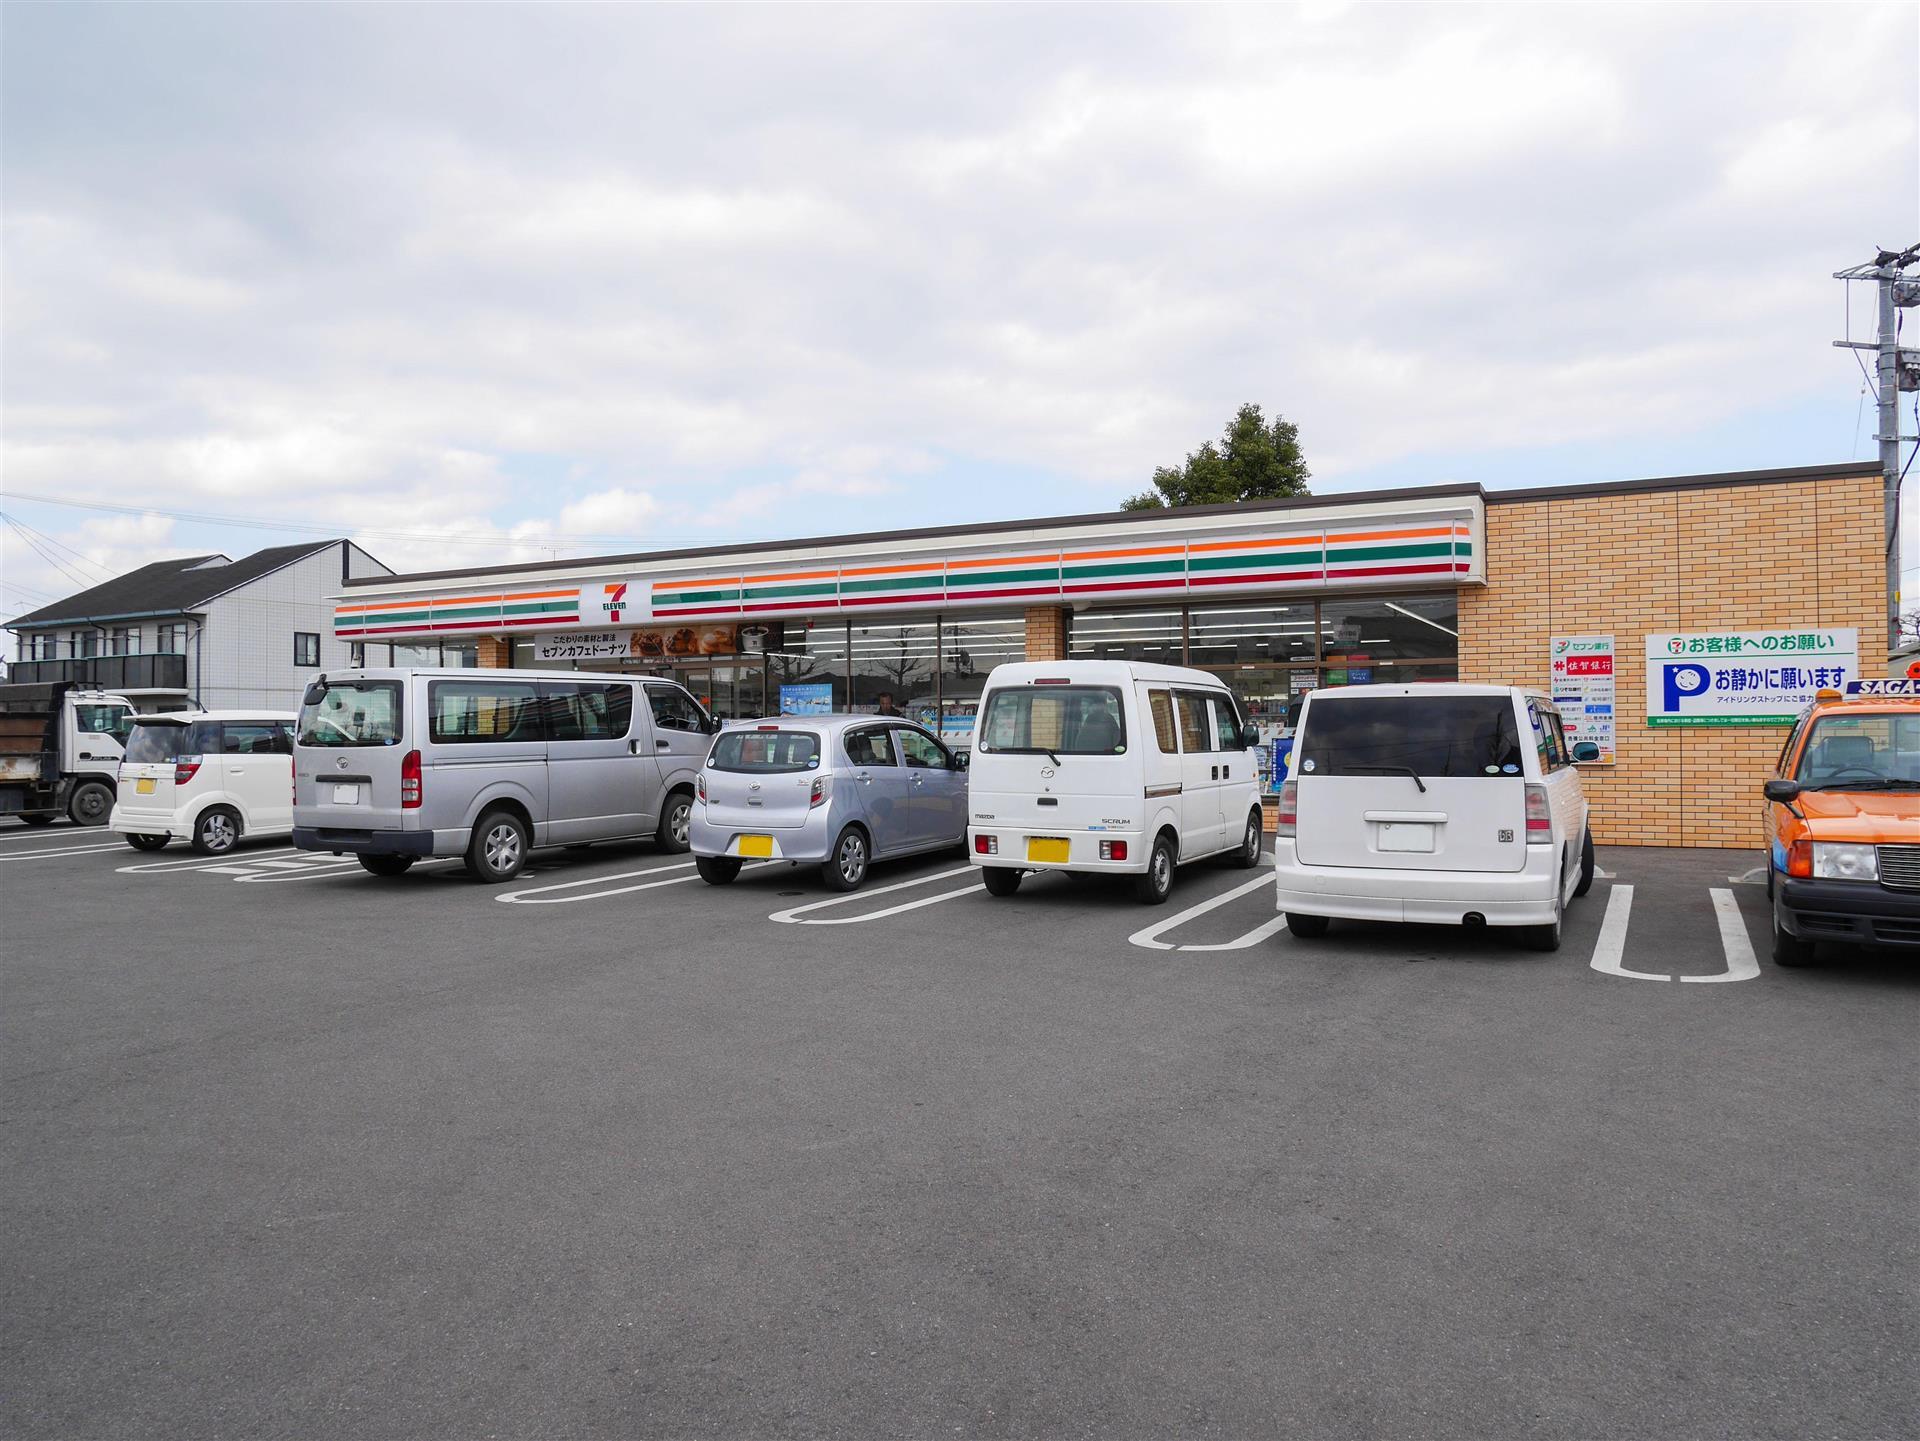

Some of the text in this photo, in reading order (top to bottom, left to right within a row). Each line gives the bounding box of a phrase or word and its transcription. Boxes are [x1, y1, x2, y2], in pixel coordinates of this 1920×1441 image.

[1573, 643, 1609, 651] セブン銀行
[1689, 634, 1835, 653] お客様へのお願い
[542, 644, 627, 657] セブンカフェドーナツ
[1567, 660, 1612, 671] 佐賀銀行
[1715, 666, 1846, 691] お静かに願います
